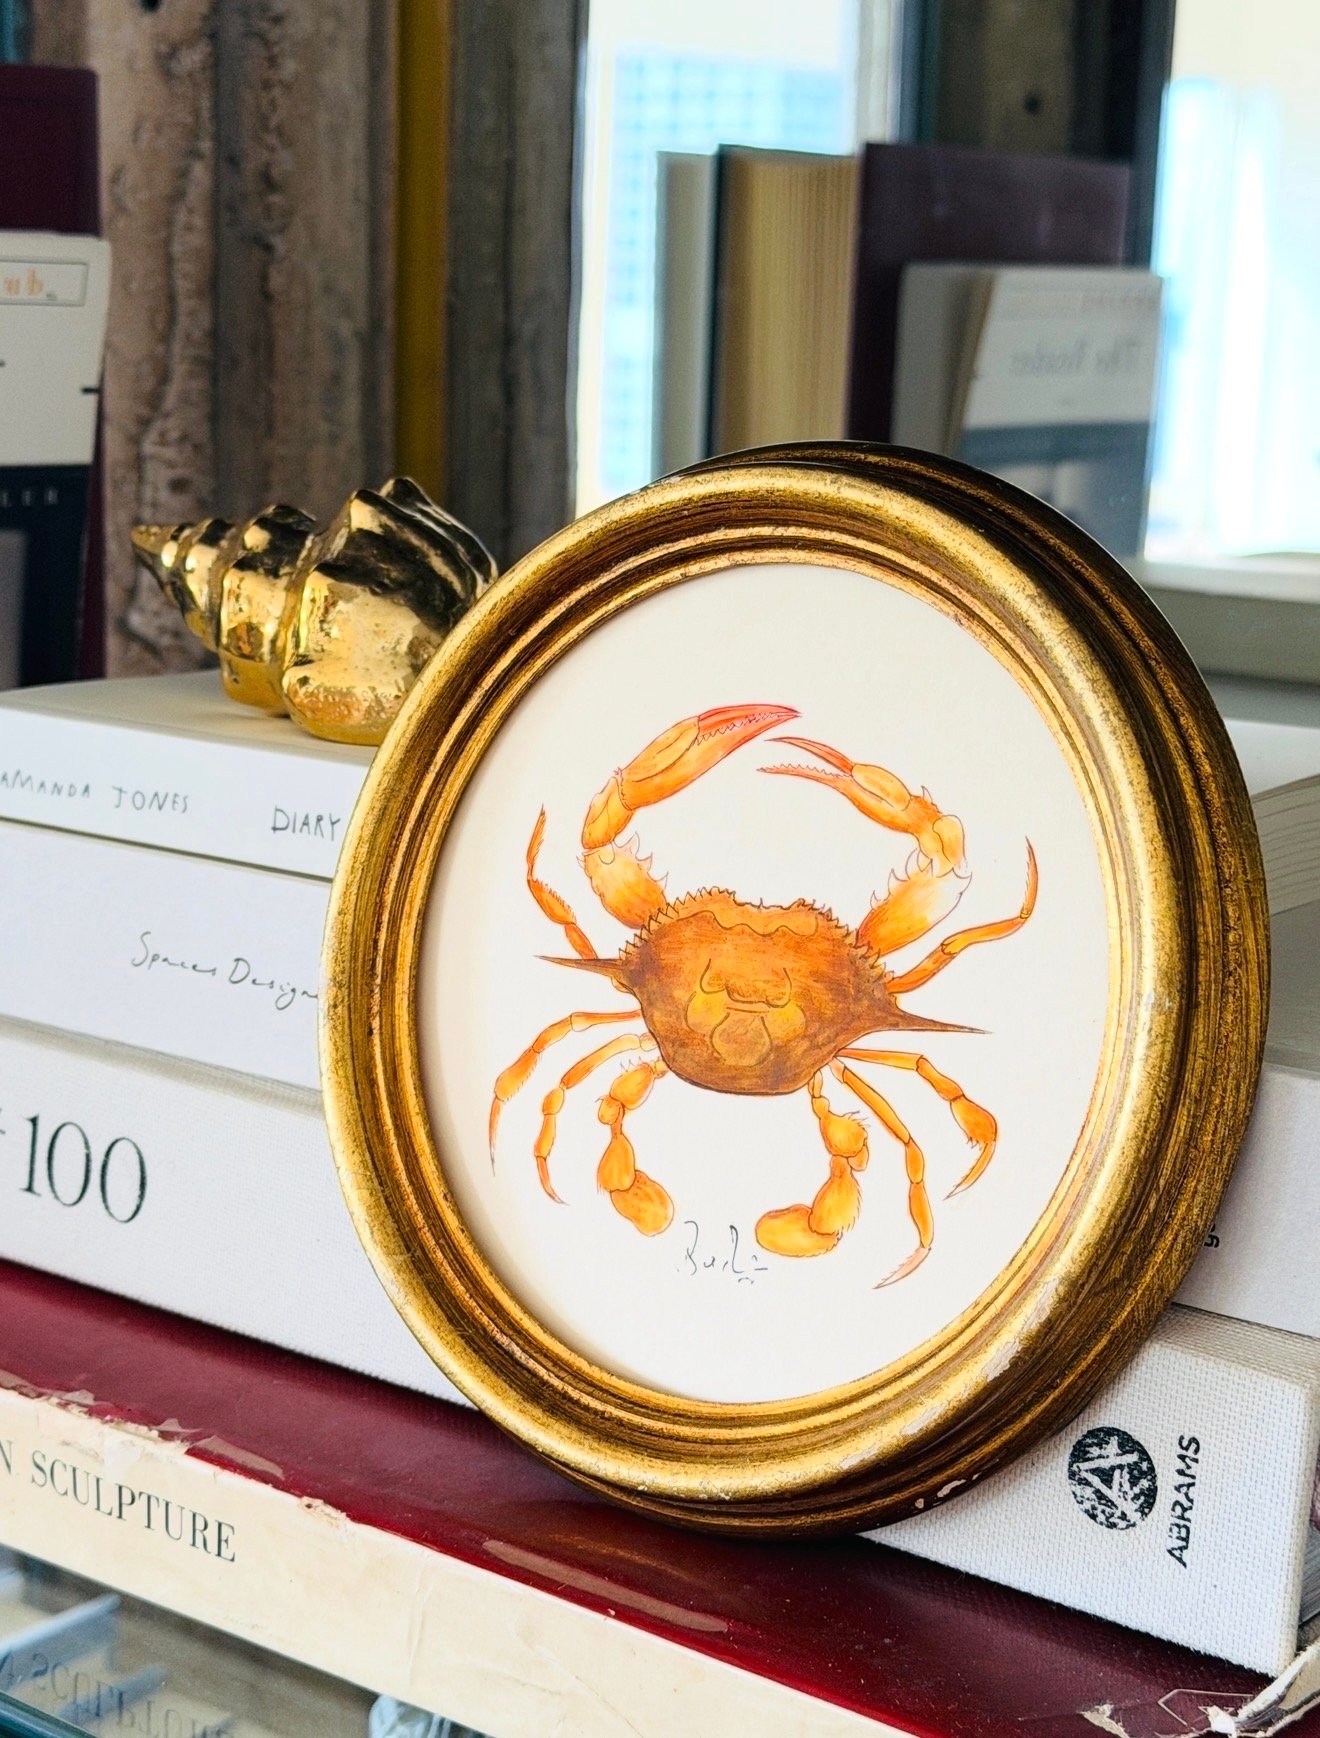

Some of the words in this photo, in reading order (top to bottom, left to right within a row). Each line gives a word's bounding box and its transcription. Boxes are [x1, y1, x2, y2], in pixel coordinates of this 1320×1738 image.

[0, 769, 91, 799] AMANDA
[112, 785, 190, 814] JONES
[271, 804, 341, 841] DIARY
[19, 1113, 147, 1223] 100
[31, 1449, 236, 1562] SCULPTURE
[1166, 1434, 1201, 1569] ABRAMS
